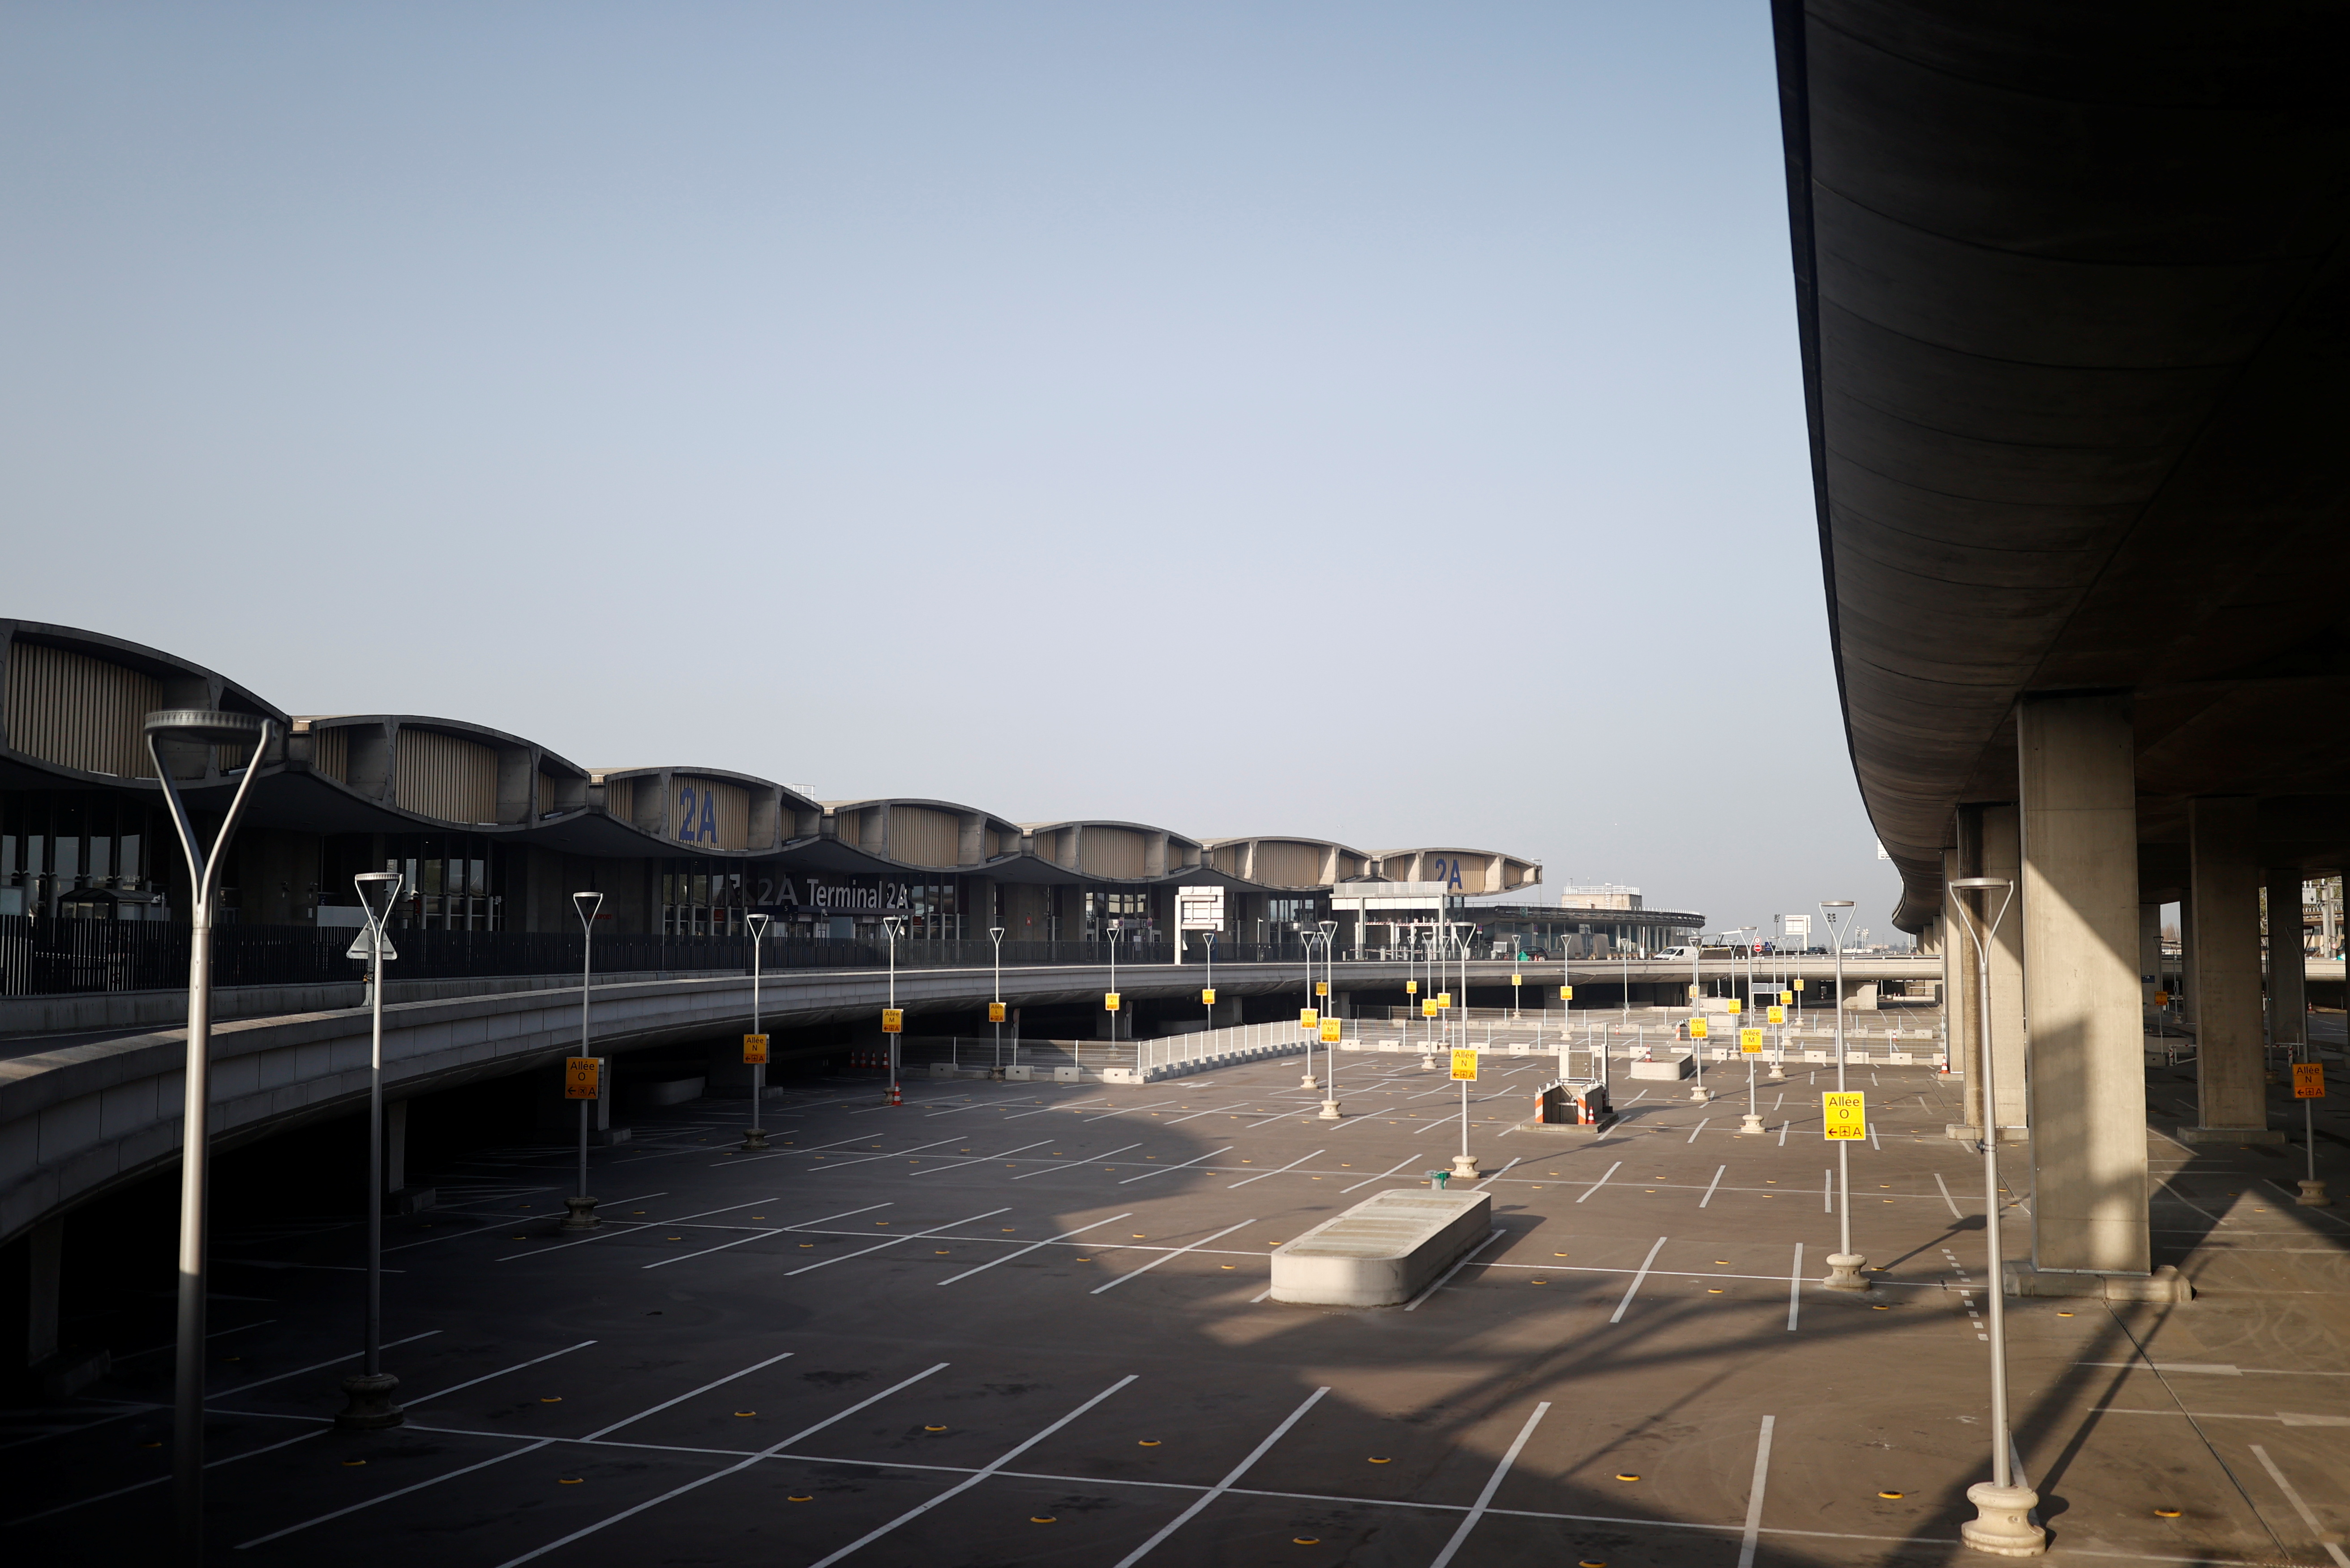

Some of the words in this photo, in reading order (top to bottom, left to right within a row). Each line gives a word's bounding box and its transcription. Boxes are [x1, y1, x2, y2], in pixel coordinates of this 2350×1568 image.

[679, 787, 717, 844] 2A
[1436, 859, 1462, 889] 2A
[757, 878, 798, 905] 2A
[807, 879, 882, 908] Terminal
[887, 883, 909, 909] 2A
[1454, 1051, 1475, 1059] Allée
[570, 1061, 595, 1071] Allée
[2296, 1066, 2320, 1074] Allée
[578, 1072, 586, 1081] O
[588, 1087, 596, 1096] A
[1829, 1096, 1860, 1106] Allée
[1840, 1109, 1849, 1119] O
[1853, 1127, 1862, 1136] A
